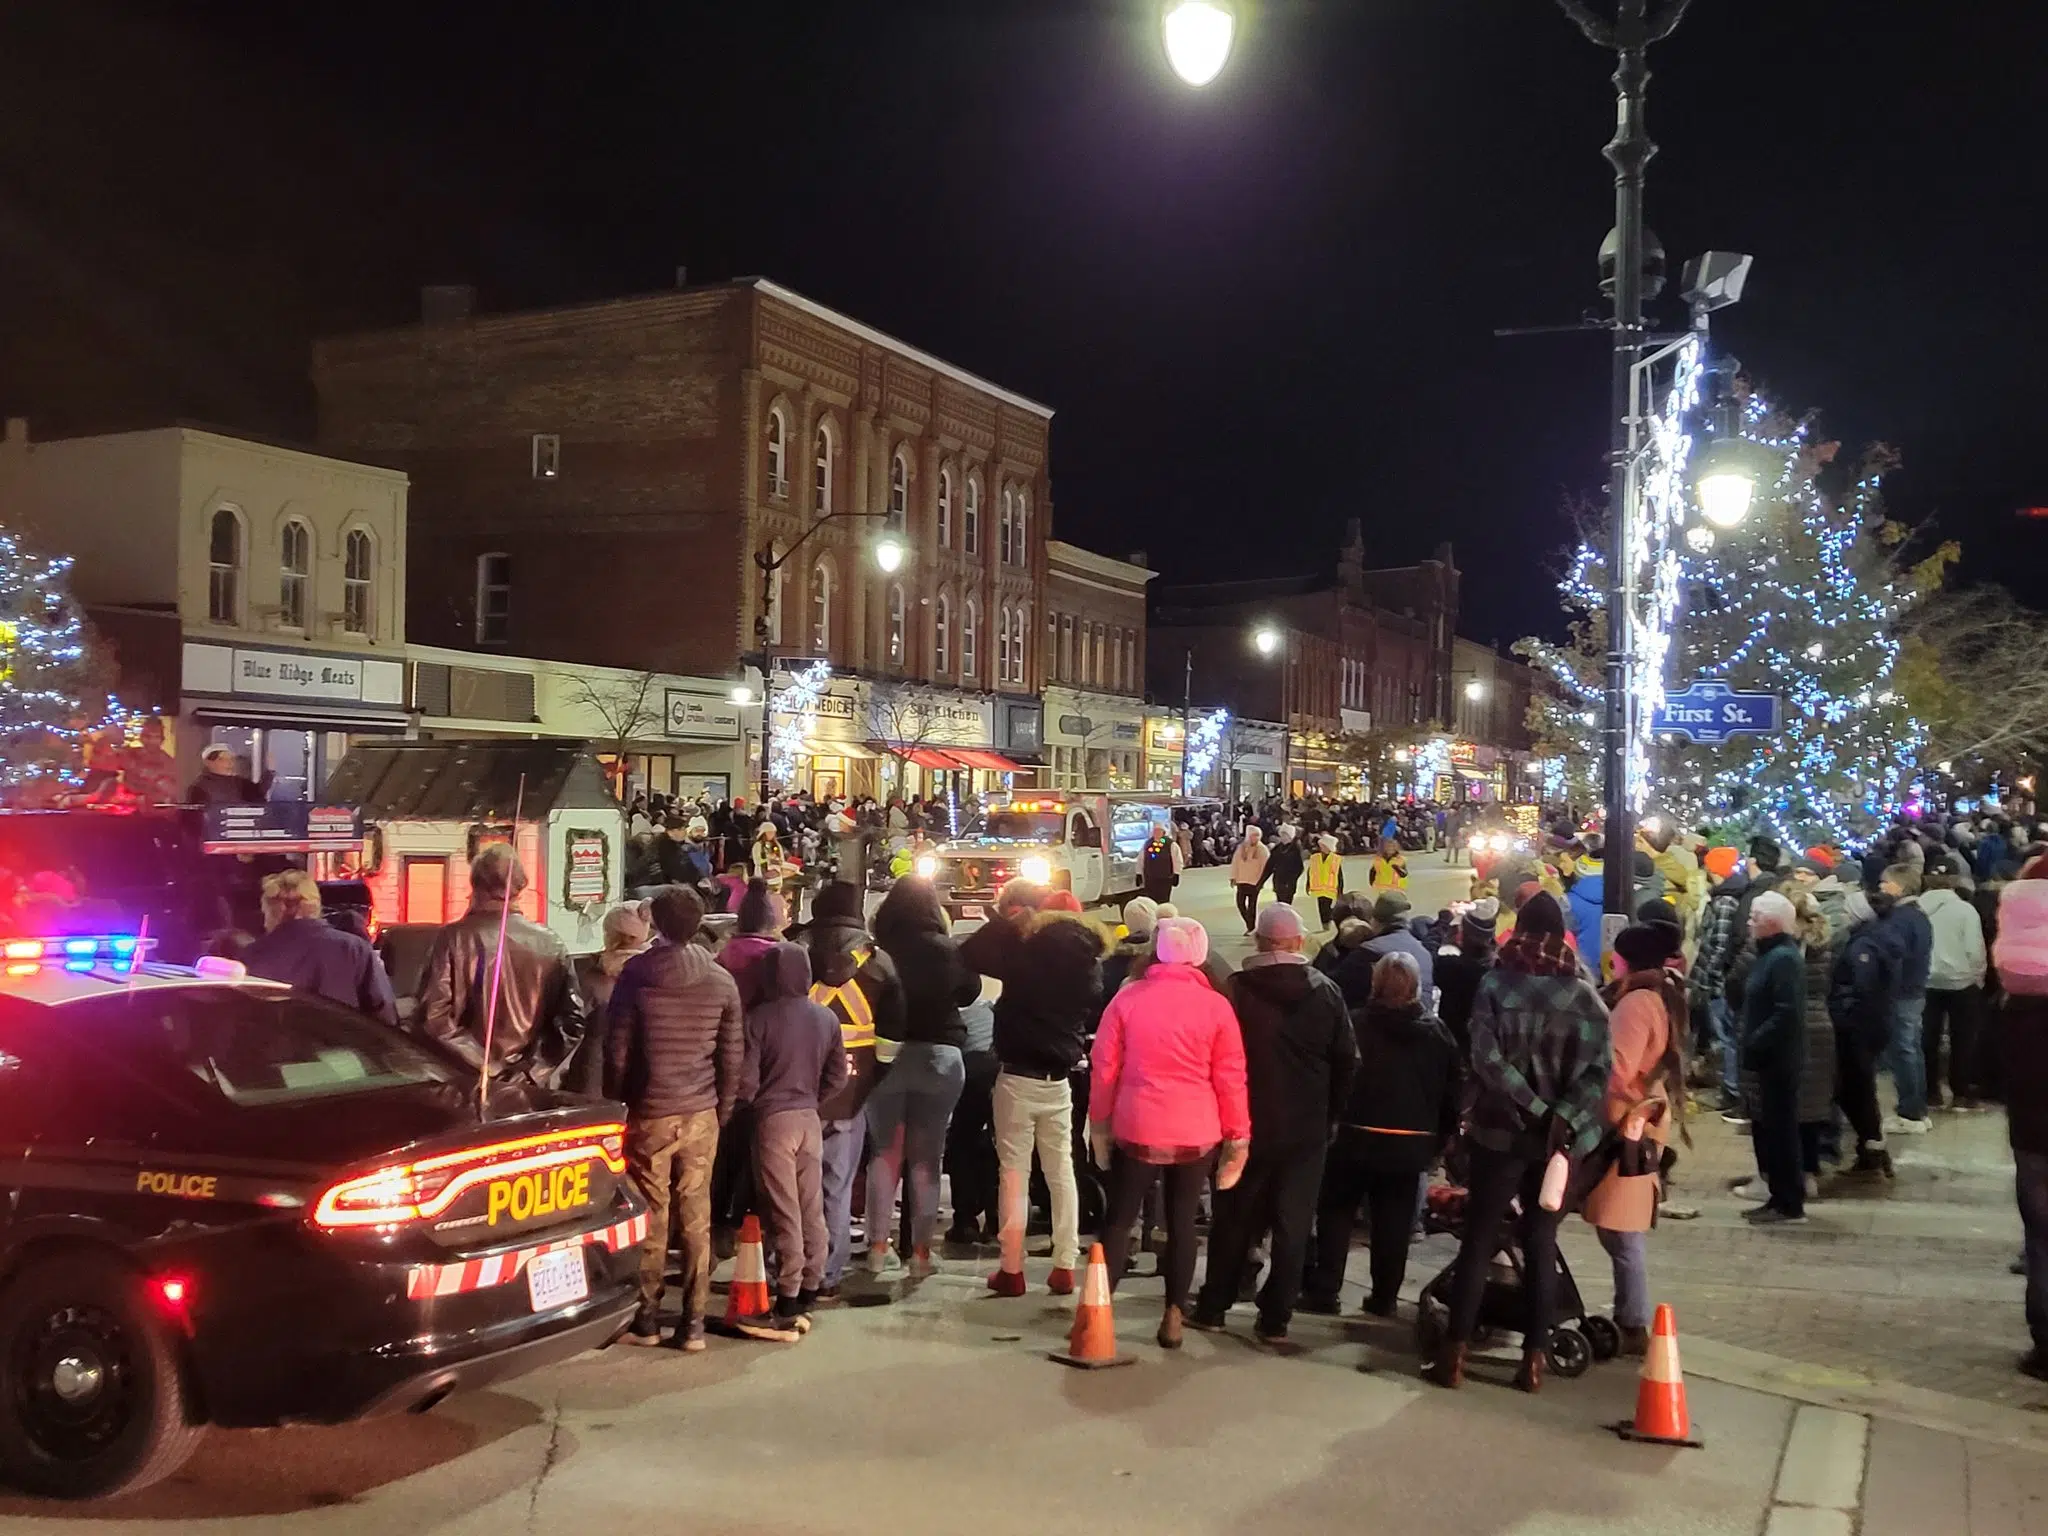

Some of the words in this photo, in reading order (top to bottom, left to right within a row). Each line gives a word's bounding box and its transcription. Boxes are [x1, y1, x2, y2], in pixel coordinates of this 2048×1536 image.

[242, 660, 271, 678] Blue
[279, 663, 313, 686] Ridge
[321, 667, 355, 685] Meats
[934, 705, 979, 721] Kitchen
[1663, 703, 1714, 722] First
[1722, 703, 1753, 723] St.
[136, 1171, 217, 1197] POLICE
[487, 1162, 590, 1226] POLICE
